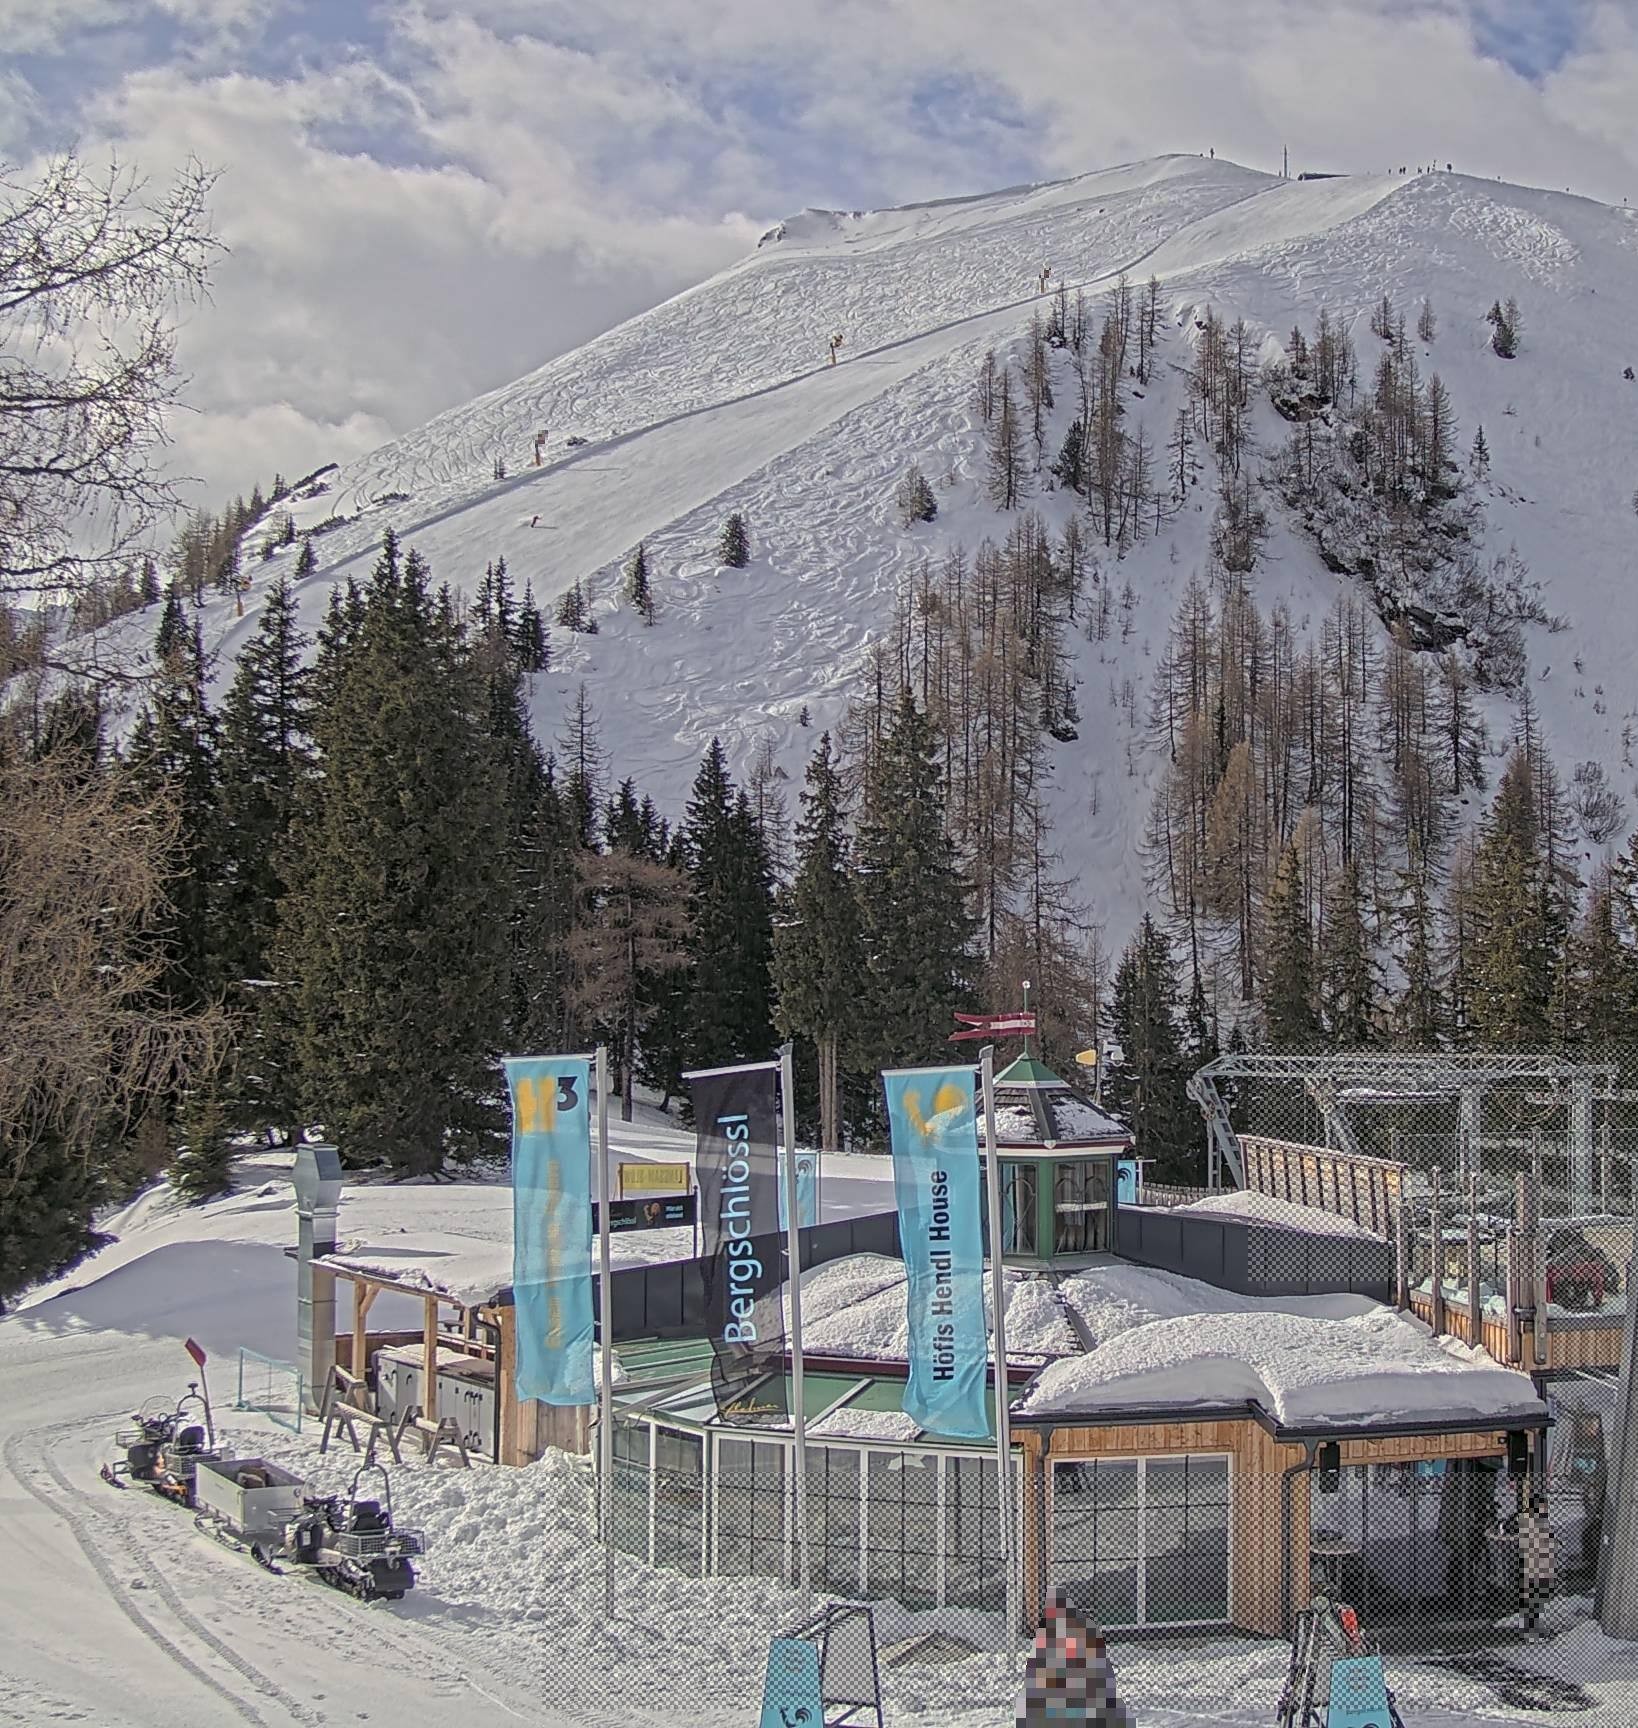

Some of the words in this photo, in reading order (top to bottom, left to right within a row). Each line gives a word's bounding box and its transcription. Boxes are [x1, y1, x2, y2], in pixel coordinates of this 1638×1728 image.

[718, 1114, 763, 1343] Bergschlössl
[929, 1170, 951, 1241] House
[930, 1250, 953, 1316] Hendl
[932, 1323, 955, 1381] Höfis
